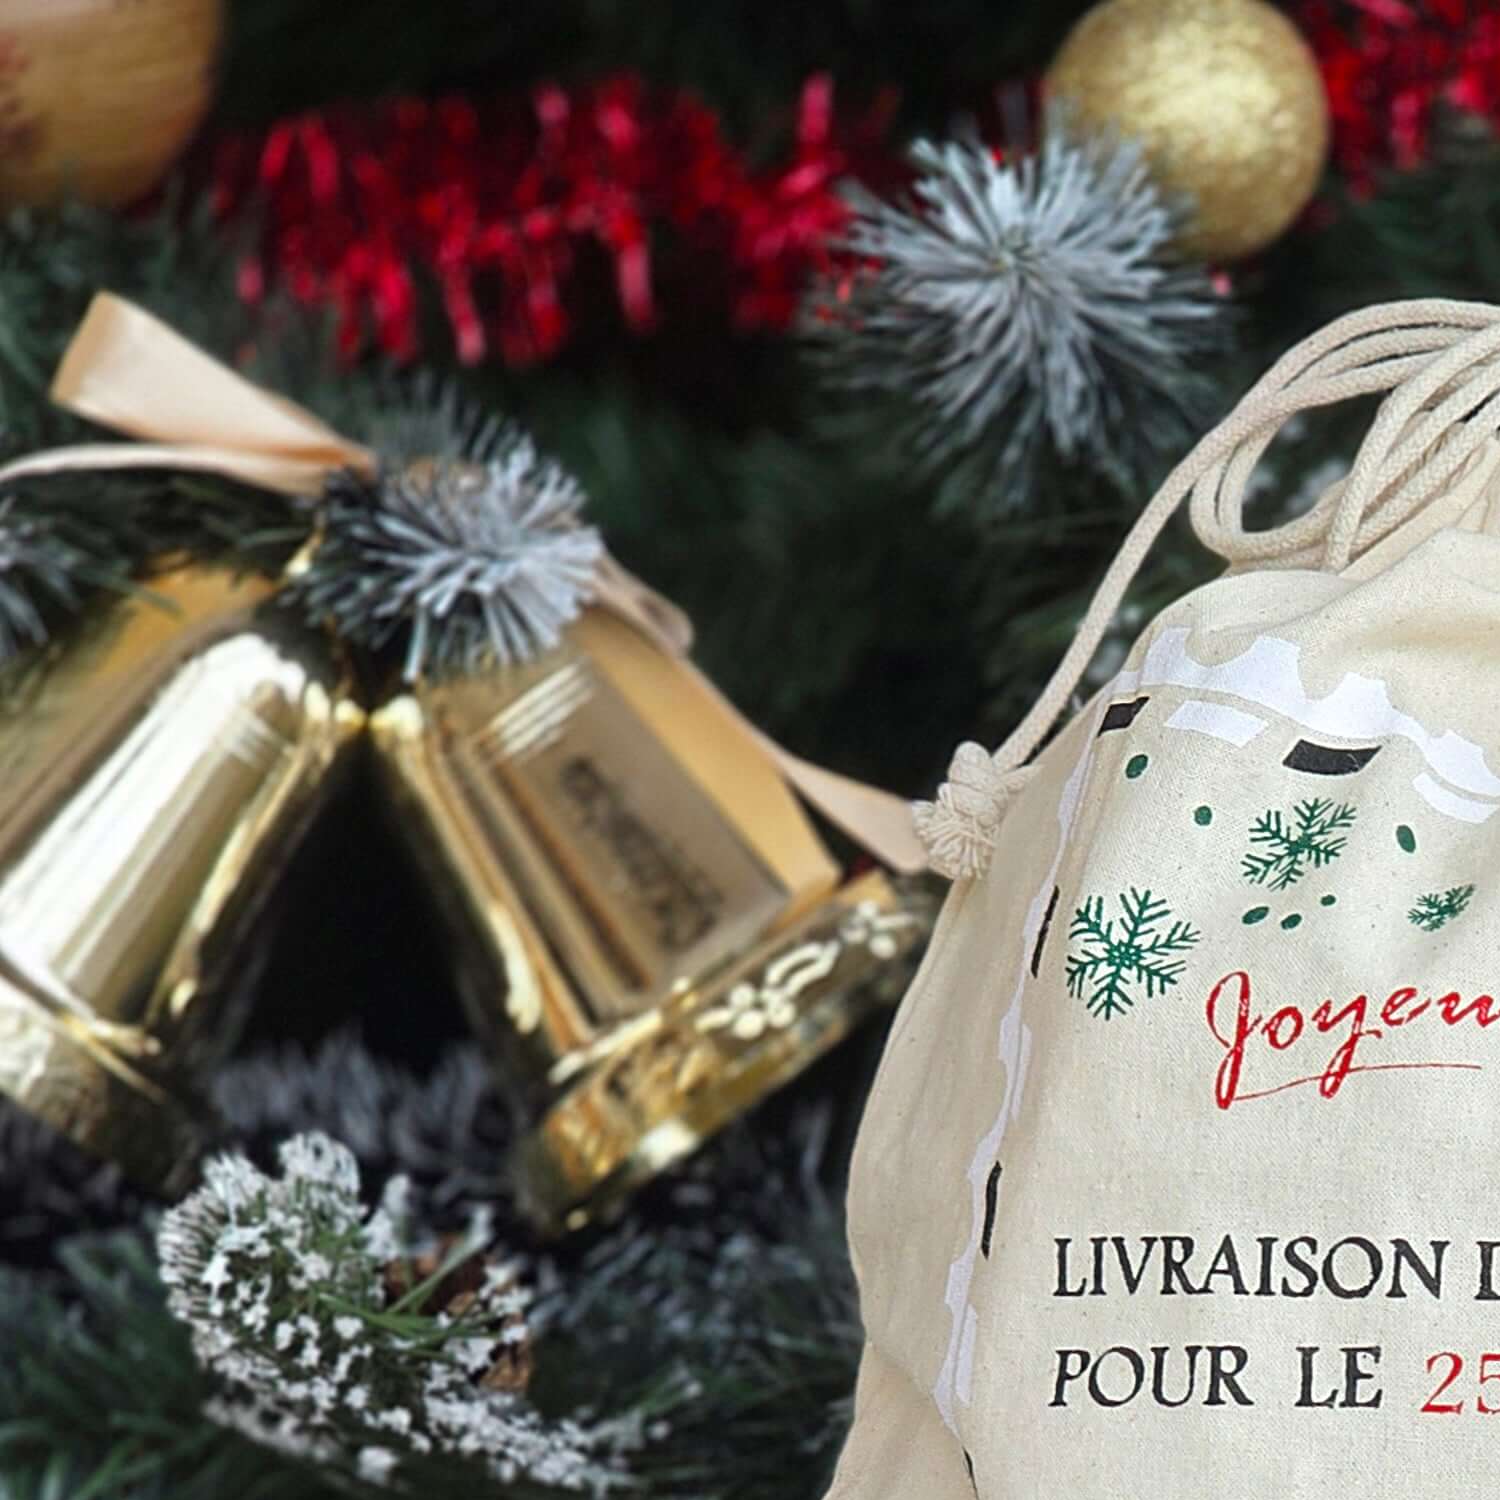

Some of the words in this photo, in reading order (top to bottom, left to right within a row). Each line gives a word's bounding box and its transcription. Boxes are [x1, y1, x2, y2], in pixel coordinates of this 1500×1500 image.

[1052, 1234, 1451, 1300] LIVRAISON
[1047, 1345, 1255, 1408] POUR
[1294, 1345, 1384, 1409] LE
